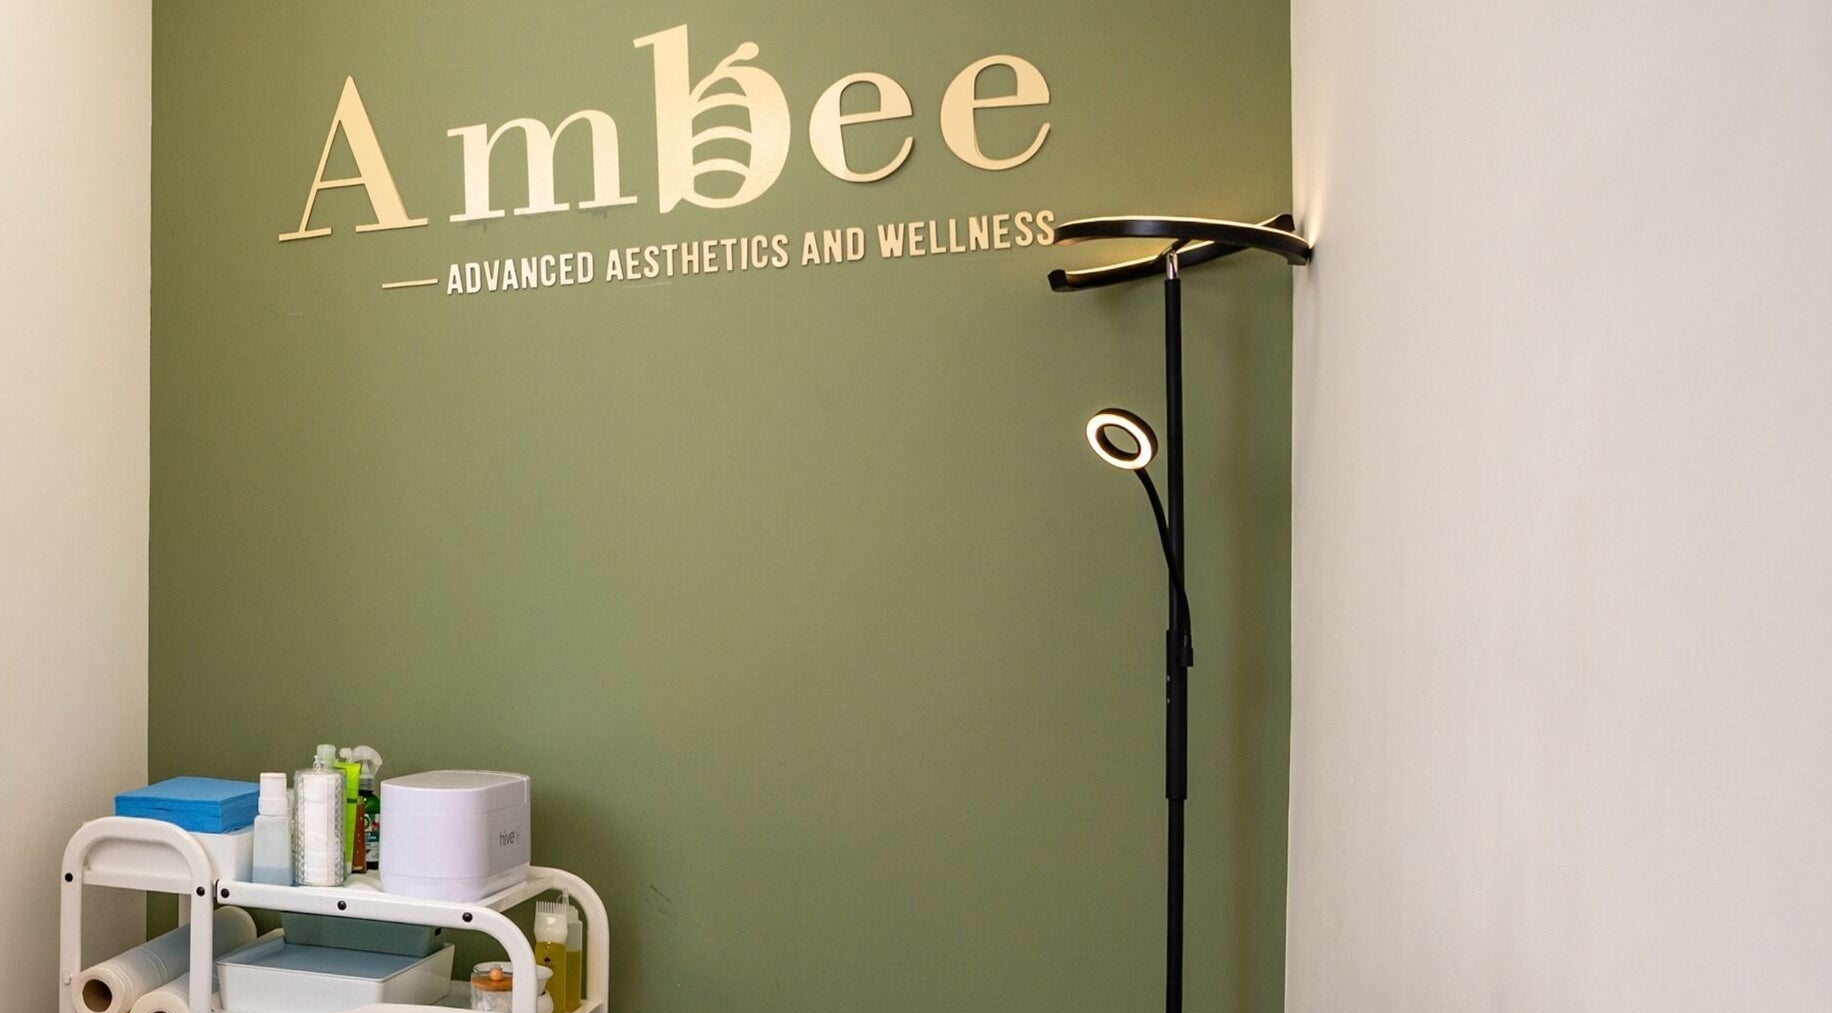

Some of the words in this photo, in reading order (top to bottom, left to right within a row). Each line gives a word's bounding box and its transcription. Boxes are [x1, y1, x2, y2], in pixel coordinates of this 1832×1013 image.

[278, 24, 1051, 242] Ambee
[447, 251, 595, 295] ADVANCED
[606, 234, 790, 282] AESTHETICS
[801, 227, 866, 267] AND
[878, 210, 1056, 259] WELLNESS
